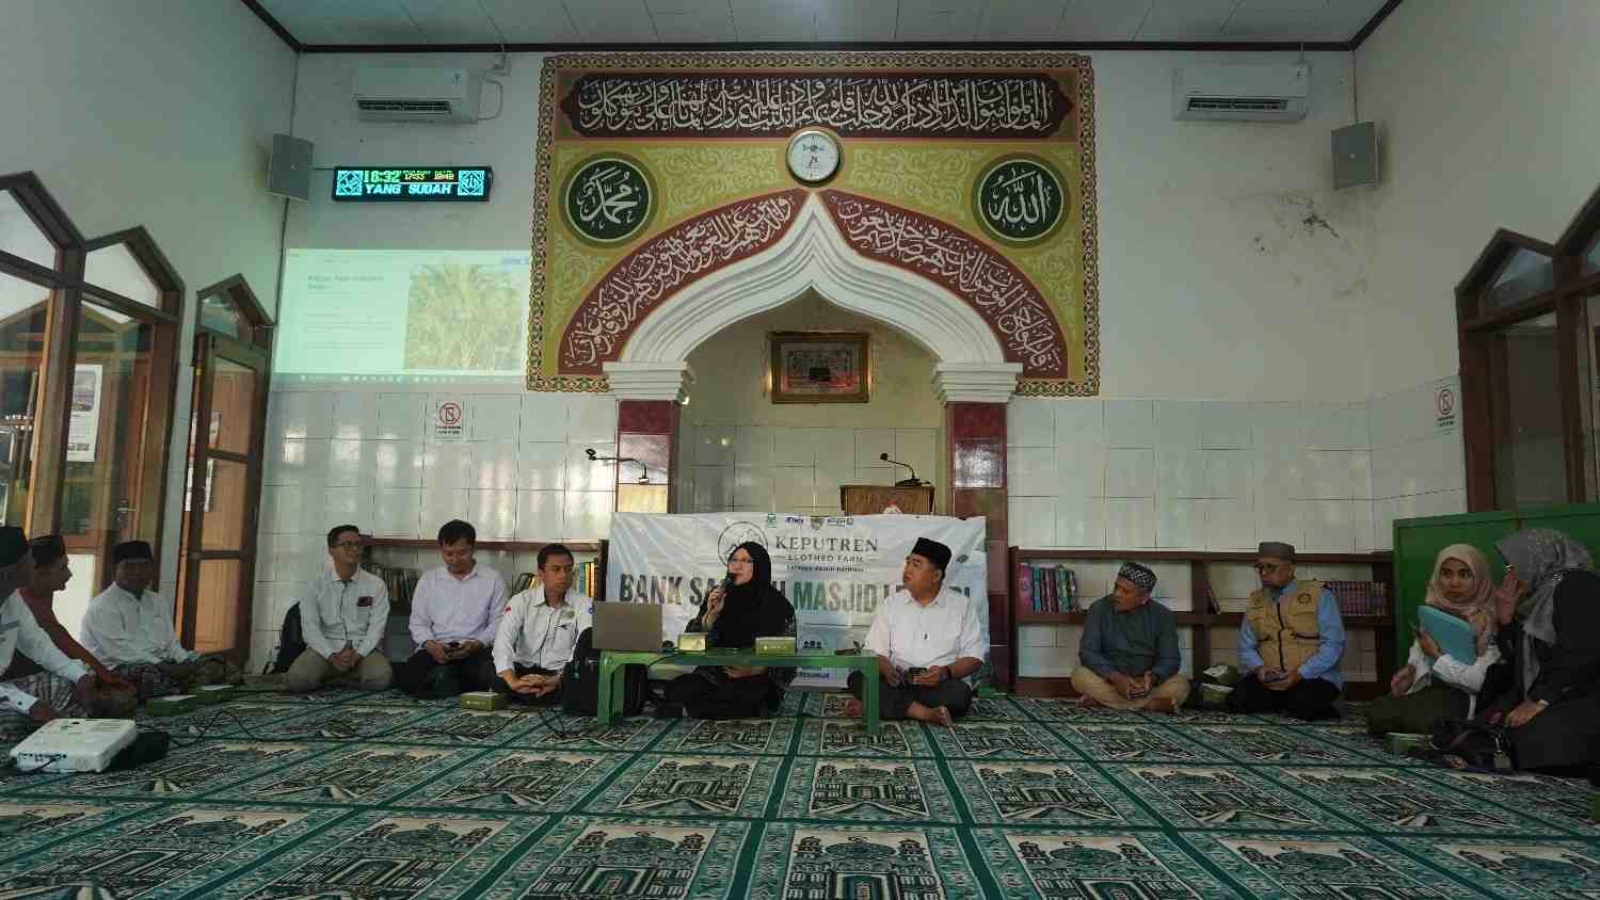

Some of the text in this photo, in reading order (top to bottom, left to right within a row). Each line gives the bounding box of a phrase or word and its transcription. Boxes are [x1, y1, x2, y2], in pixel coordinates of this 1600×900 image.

[365, 184, 451, 194] YANG SUDAH
[776, 536, 878, 553] KEPUTREN
[620, 574, 682, 605] BANK
[794, 581, 877, 613] MASJID
